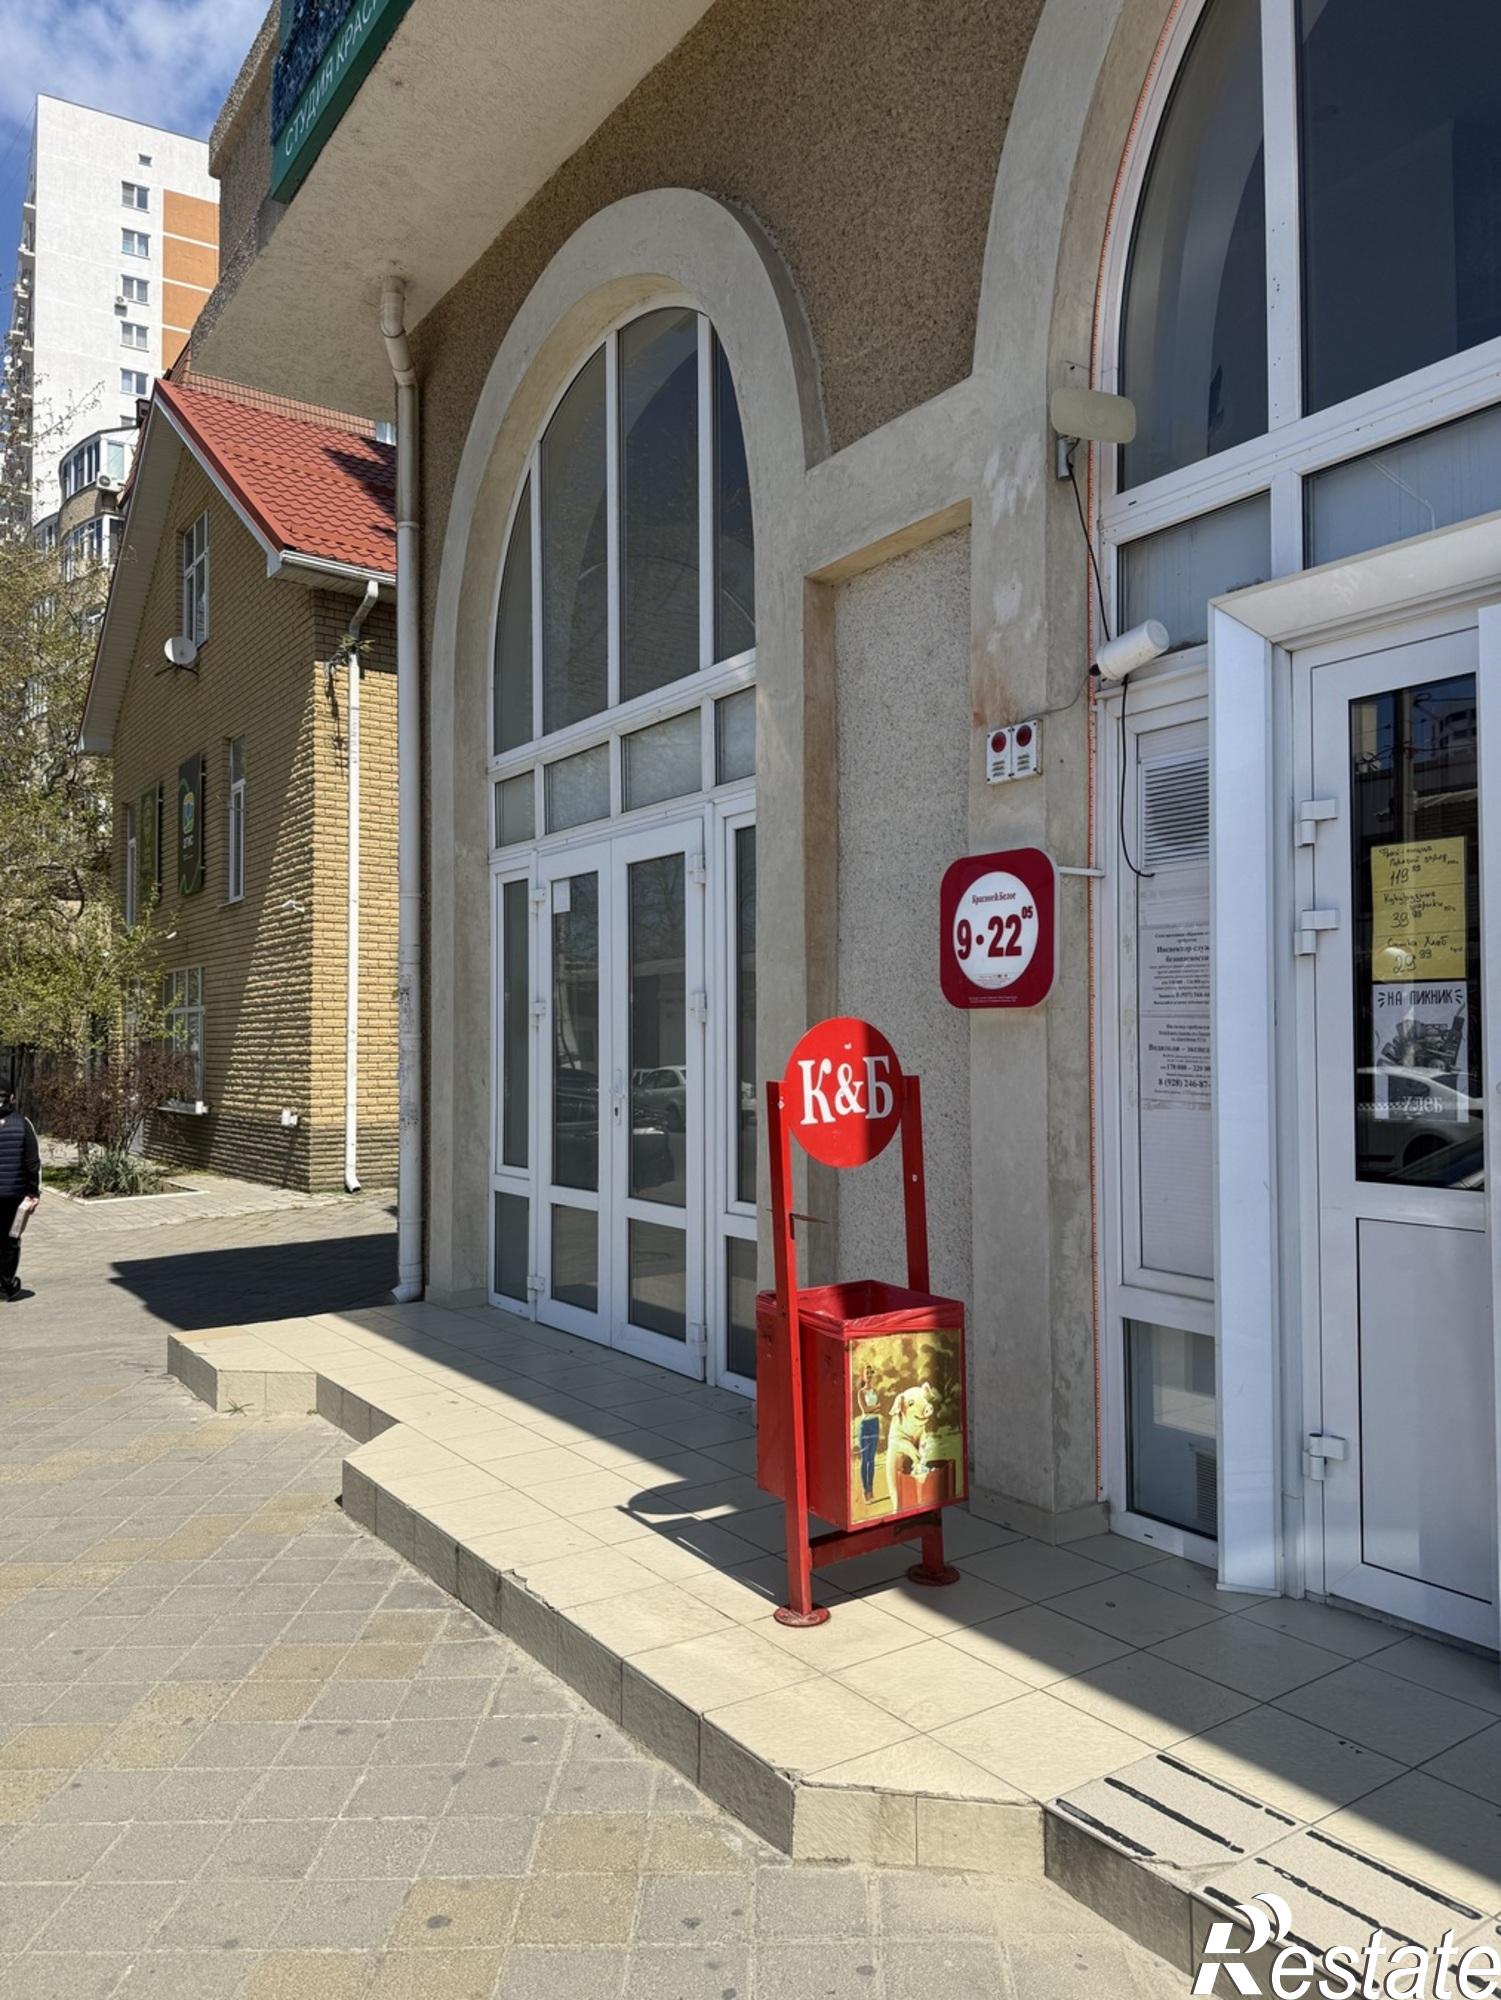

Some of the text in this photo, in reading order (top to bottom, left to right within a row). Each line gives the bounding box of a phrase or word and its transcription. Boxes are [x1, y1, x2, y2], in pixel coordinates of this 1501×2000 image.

[285, 56, 333, 156] СТУДИЯ
[1387, 989, 1453, 1006] НА ПИКНИК
[797, 1056, 893, 1125] К&Б
